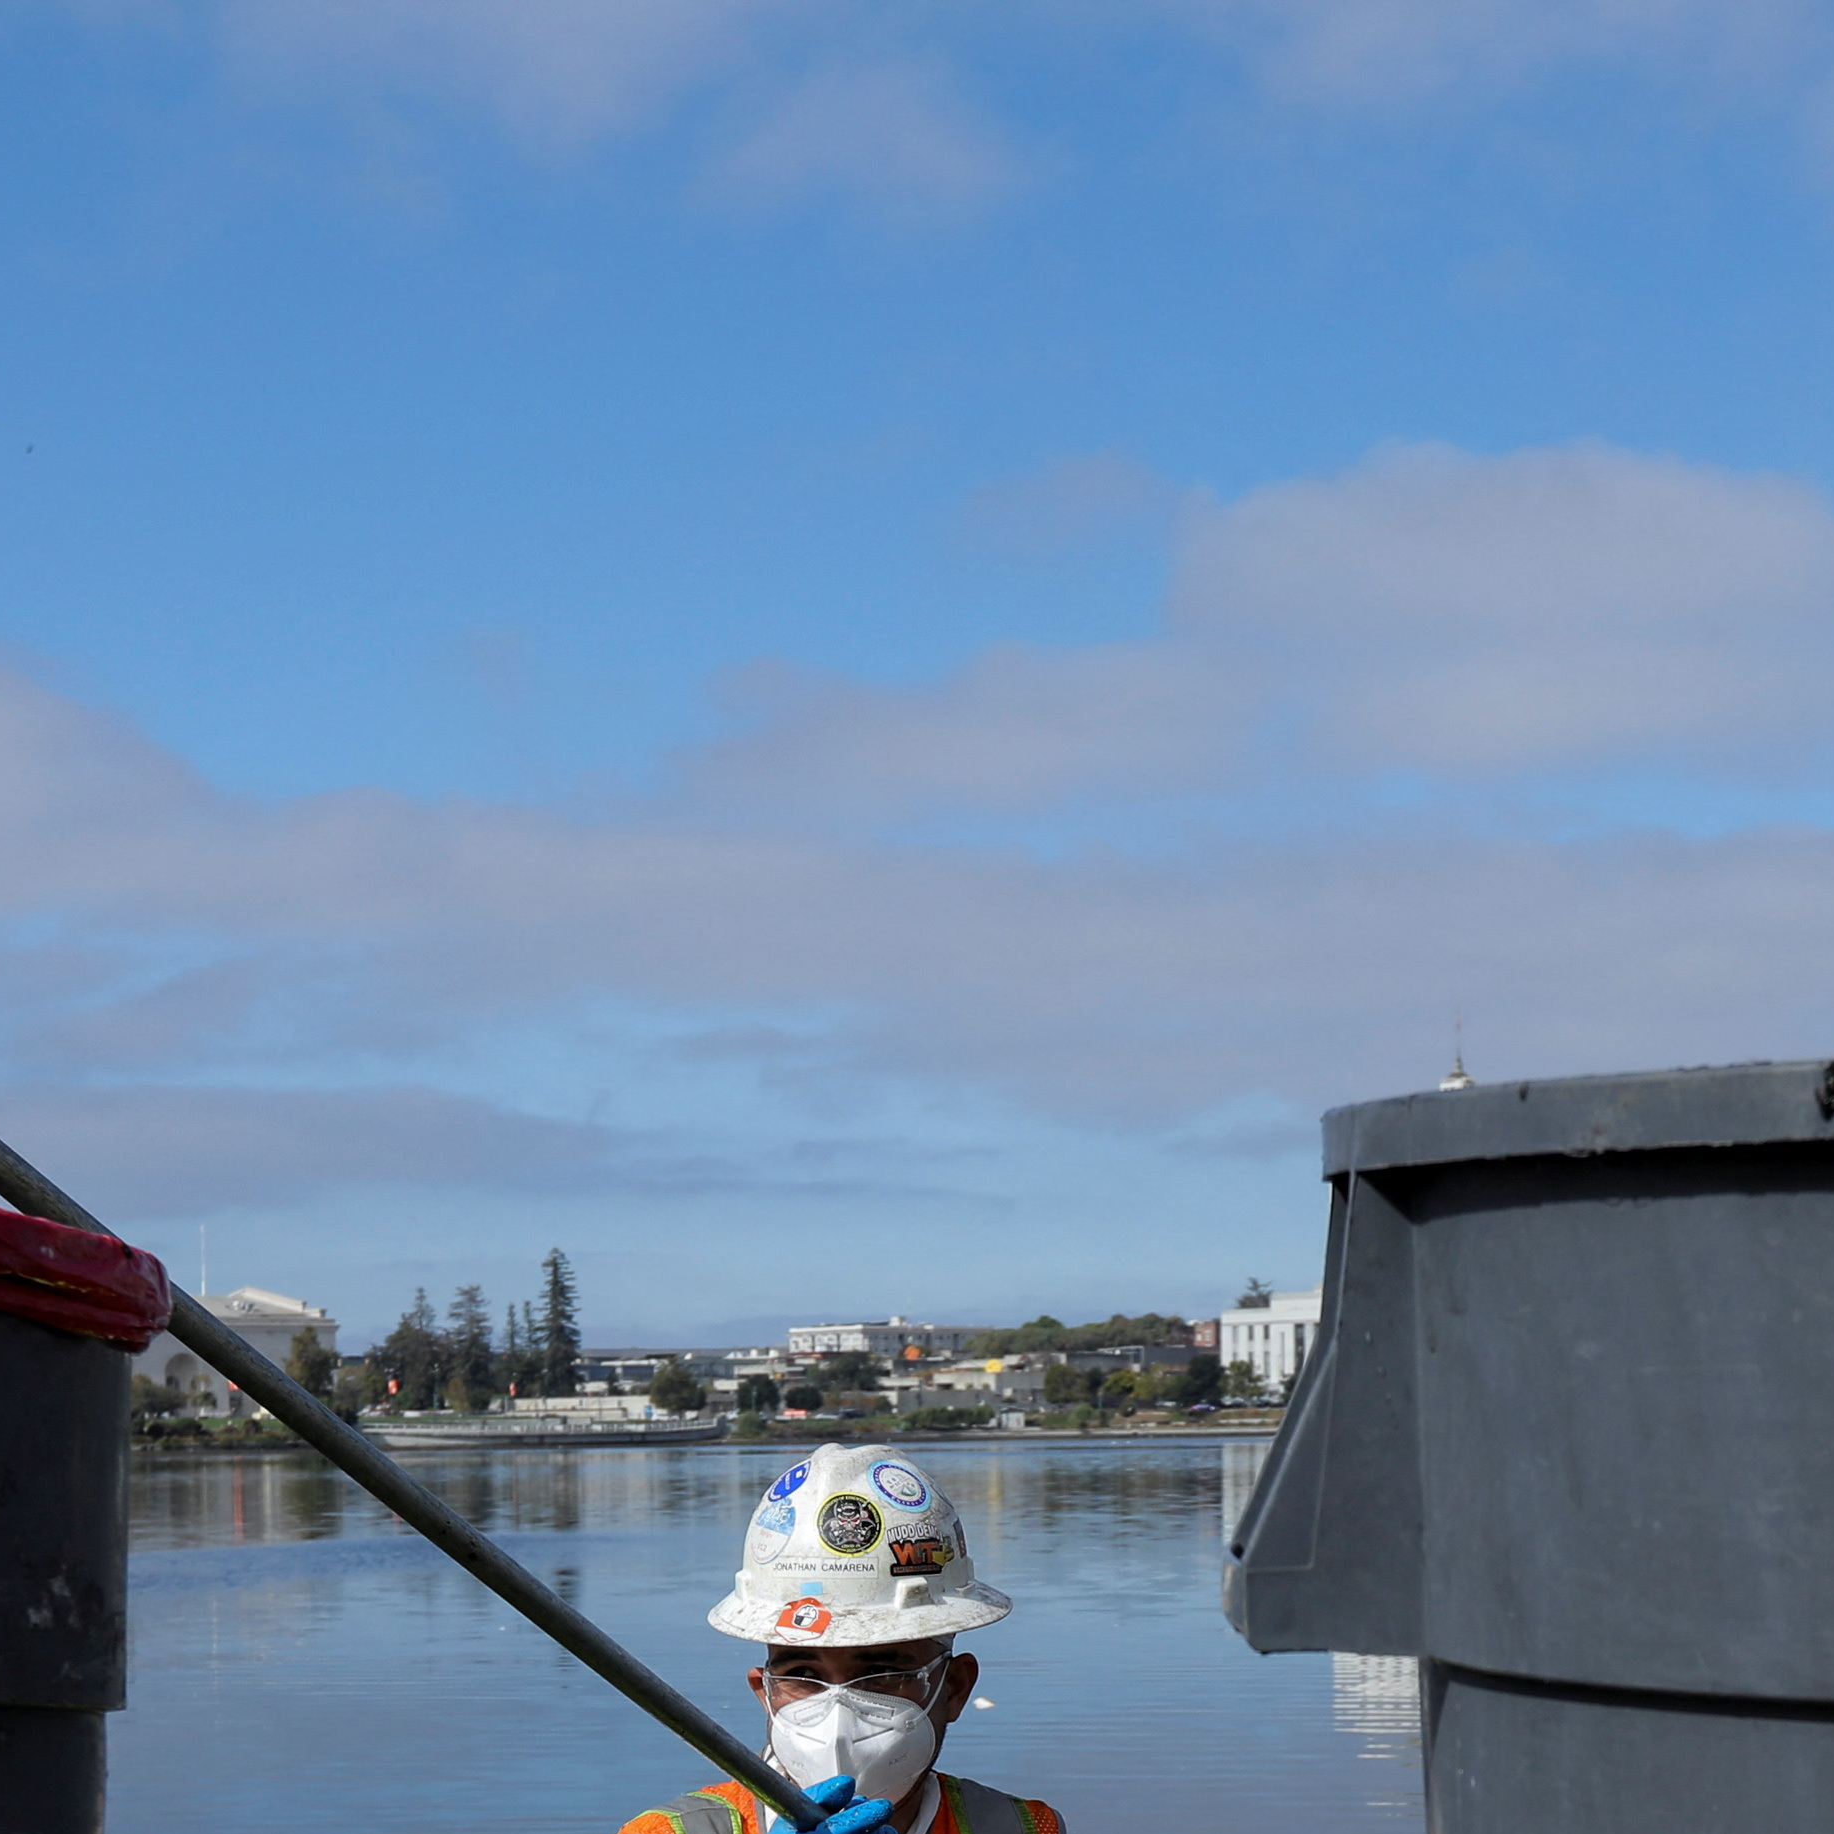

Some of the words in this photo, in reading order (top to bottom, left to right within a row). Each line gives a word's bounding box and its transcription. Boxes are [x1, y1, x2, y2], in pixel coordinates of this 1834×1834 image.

[887, 1524, 916, 1543] MUDD
[773, 1562, 817, 1572] JONATHAN
[821, 1563, 875, 1572] CAMARENA
